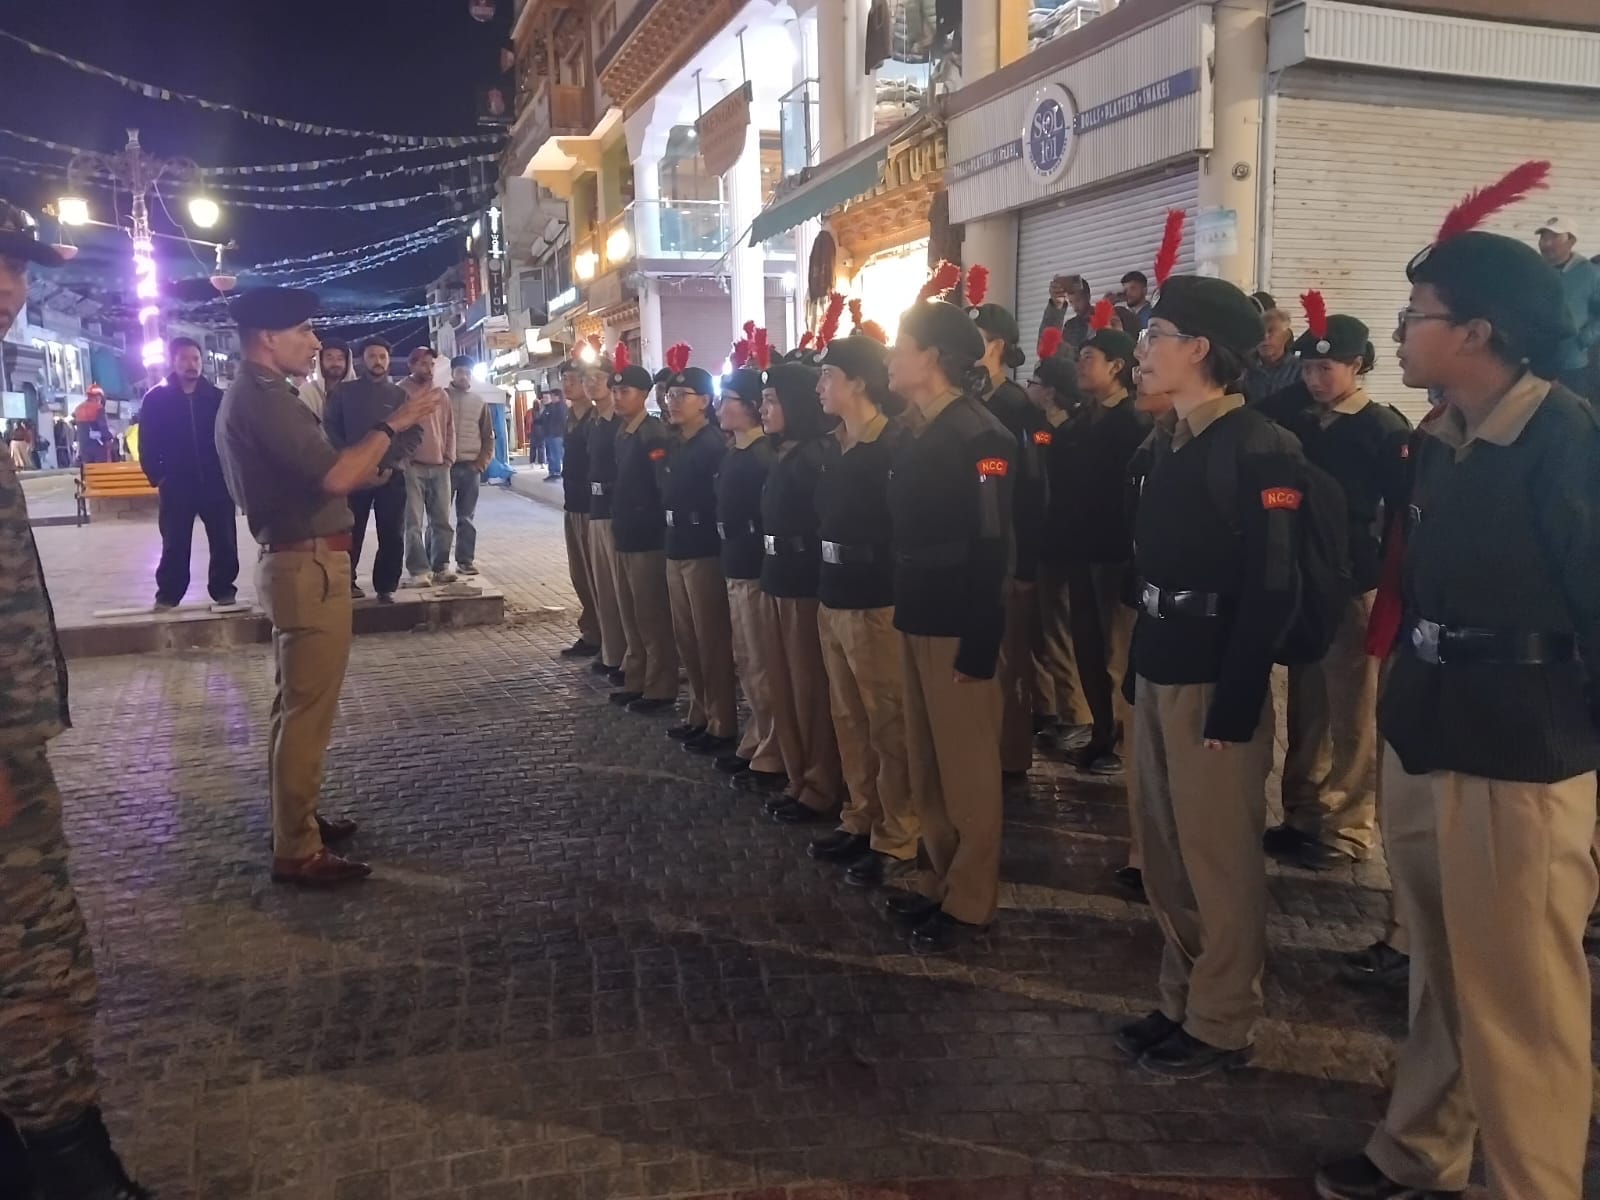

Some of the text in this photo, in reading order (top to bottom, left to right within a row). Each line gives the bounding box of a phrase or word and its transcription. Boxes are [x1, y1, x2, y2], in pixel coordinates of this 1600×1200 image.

[1105, 96, 1138, 119] PLATTERS
[1142, 80, 1171, 105] SHAKES
[1034, 105, 1064, 138] SOL
[1041, 136, 1058, 163] 101
[1034, 433, 1049, 442] NCC
[982, 461, 1004, 471] NCC
[1268, 492, 1296, 504] NCC
